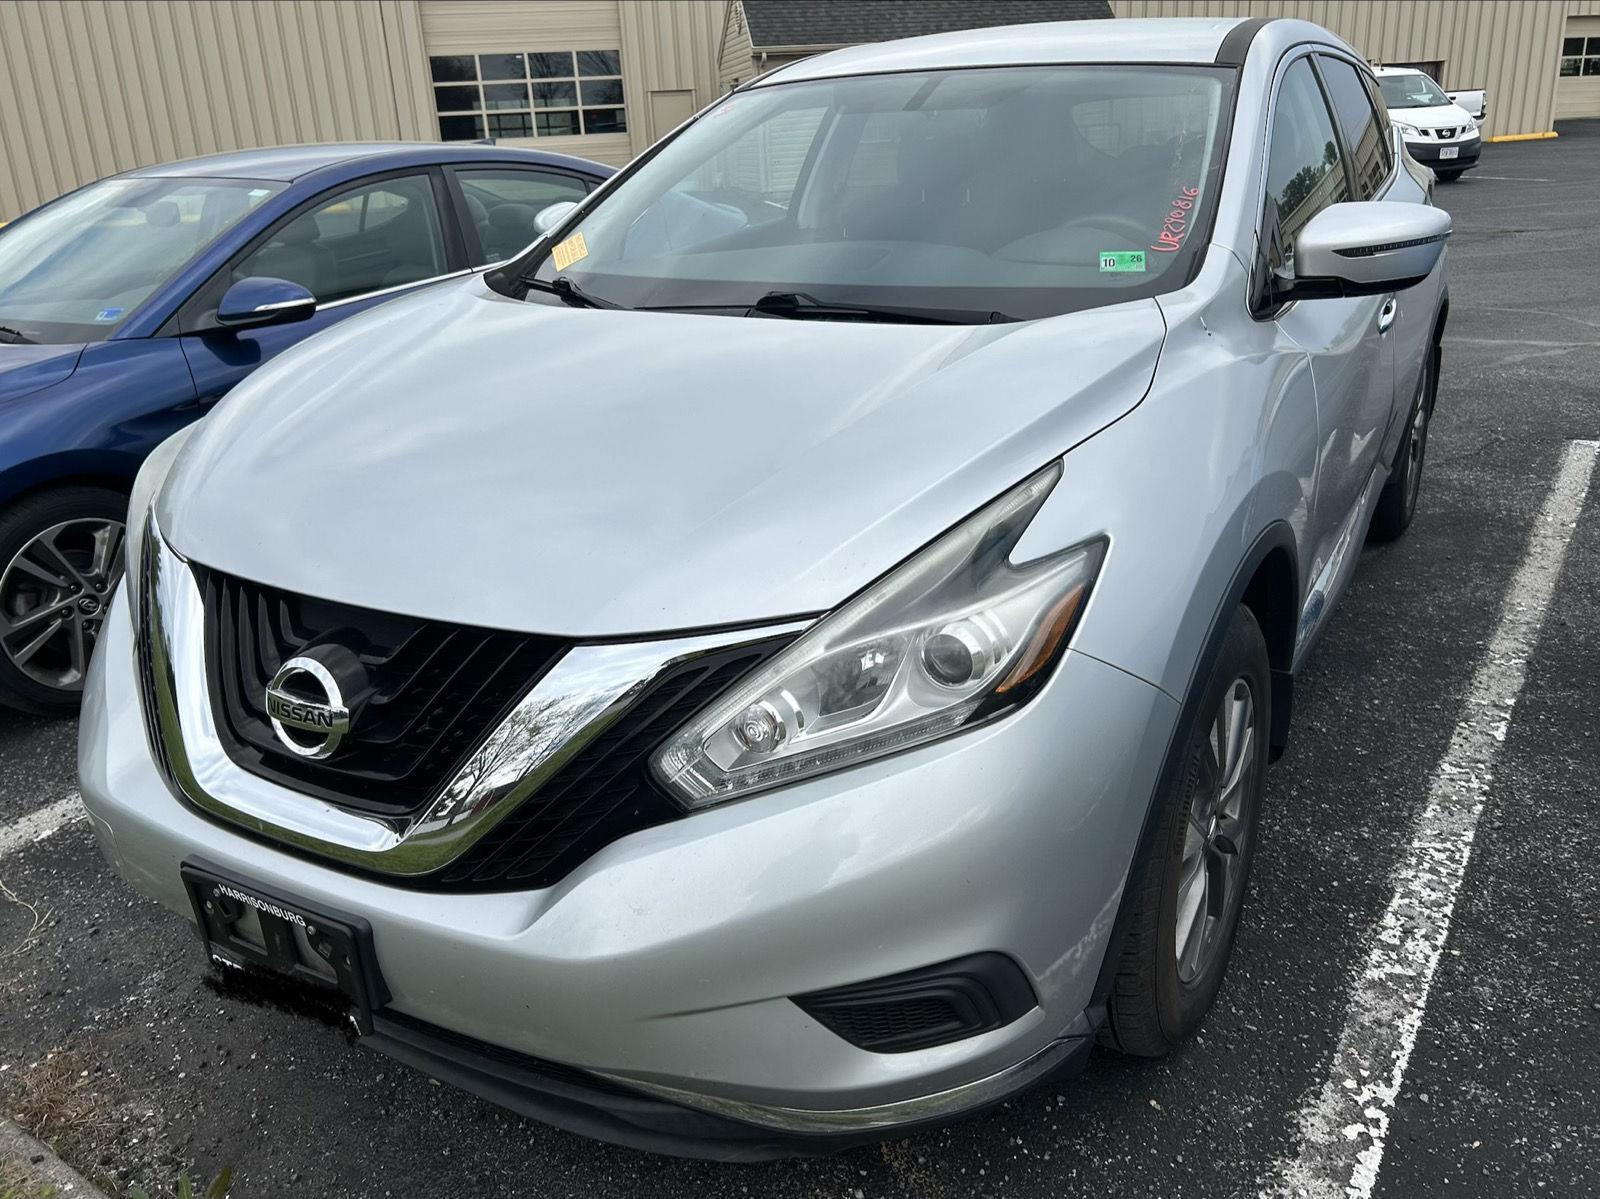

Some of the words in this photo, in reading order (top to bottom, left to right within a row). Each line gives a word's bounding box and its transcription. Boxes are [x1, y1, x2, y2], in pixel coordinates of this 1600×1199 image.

[1103, 258, 1116, 268] 10
[1130, 254, 1143, 263] 26
[267, 697, 334, 728] NISSAN
[218, 883, 307, 928] HARRISONBURG
